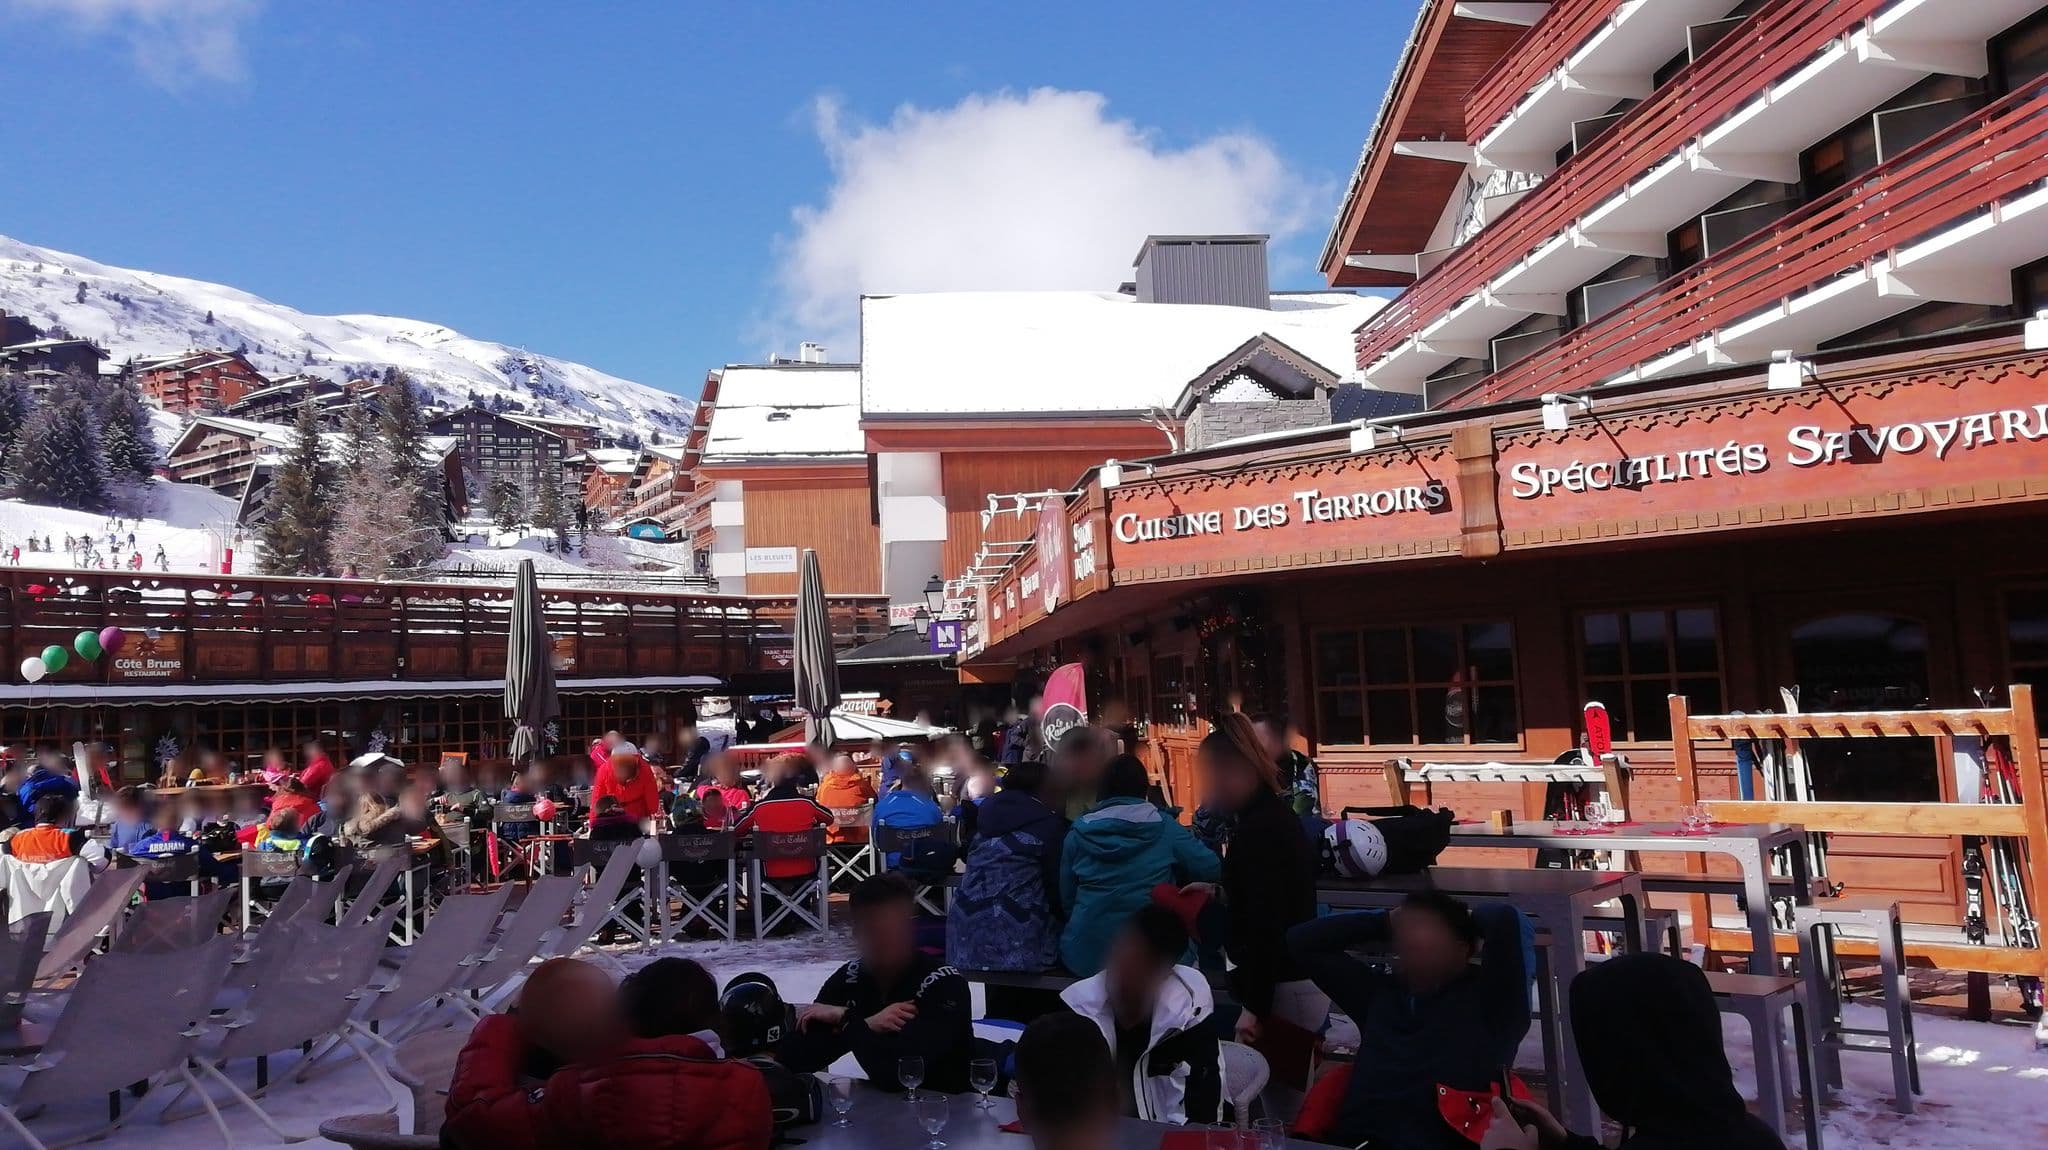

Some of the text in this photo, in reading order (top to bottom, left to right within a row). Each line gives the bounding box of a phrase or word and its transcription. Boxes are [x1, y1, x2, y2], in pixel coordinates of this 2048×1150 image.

[892, 607, 918, 618] FAS
[115, 658, 182, 669] Côte Brune
[124, 670, 171, 678] RESTAURANT
[149, 842, 185, 853] ABRAHAM
